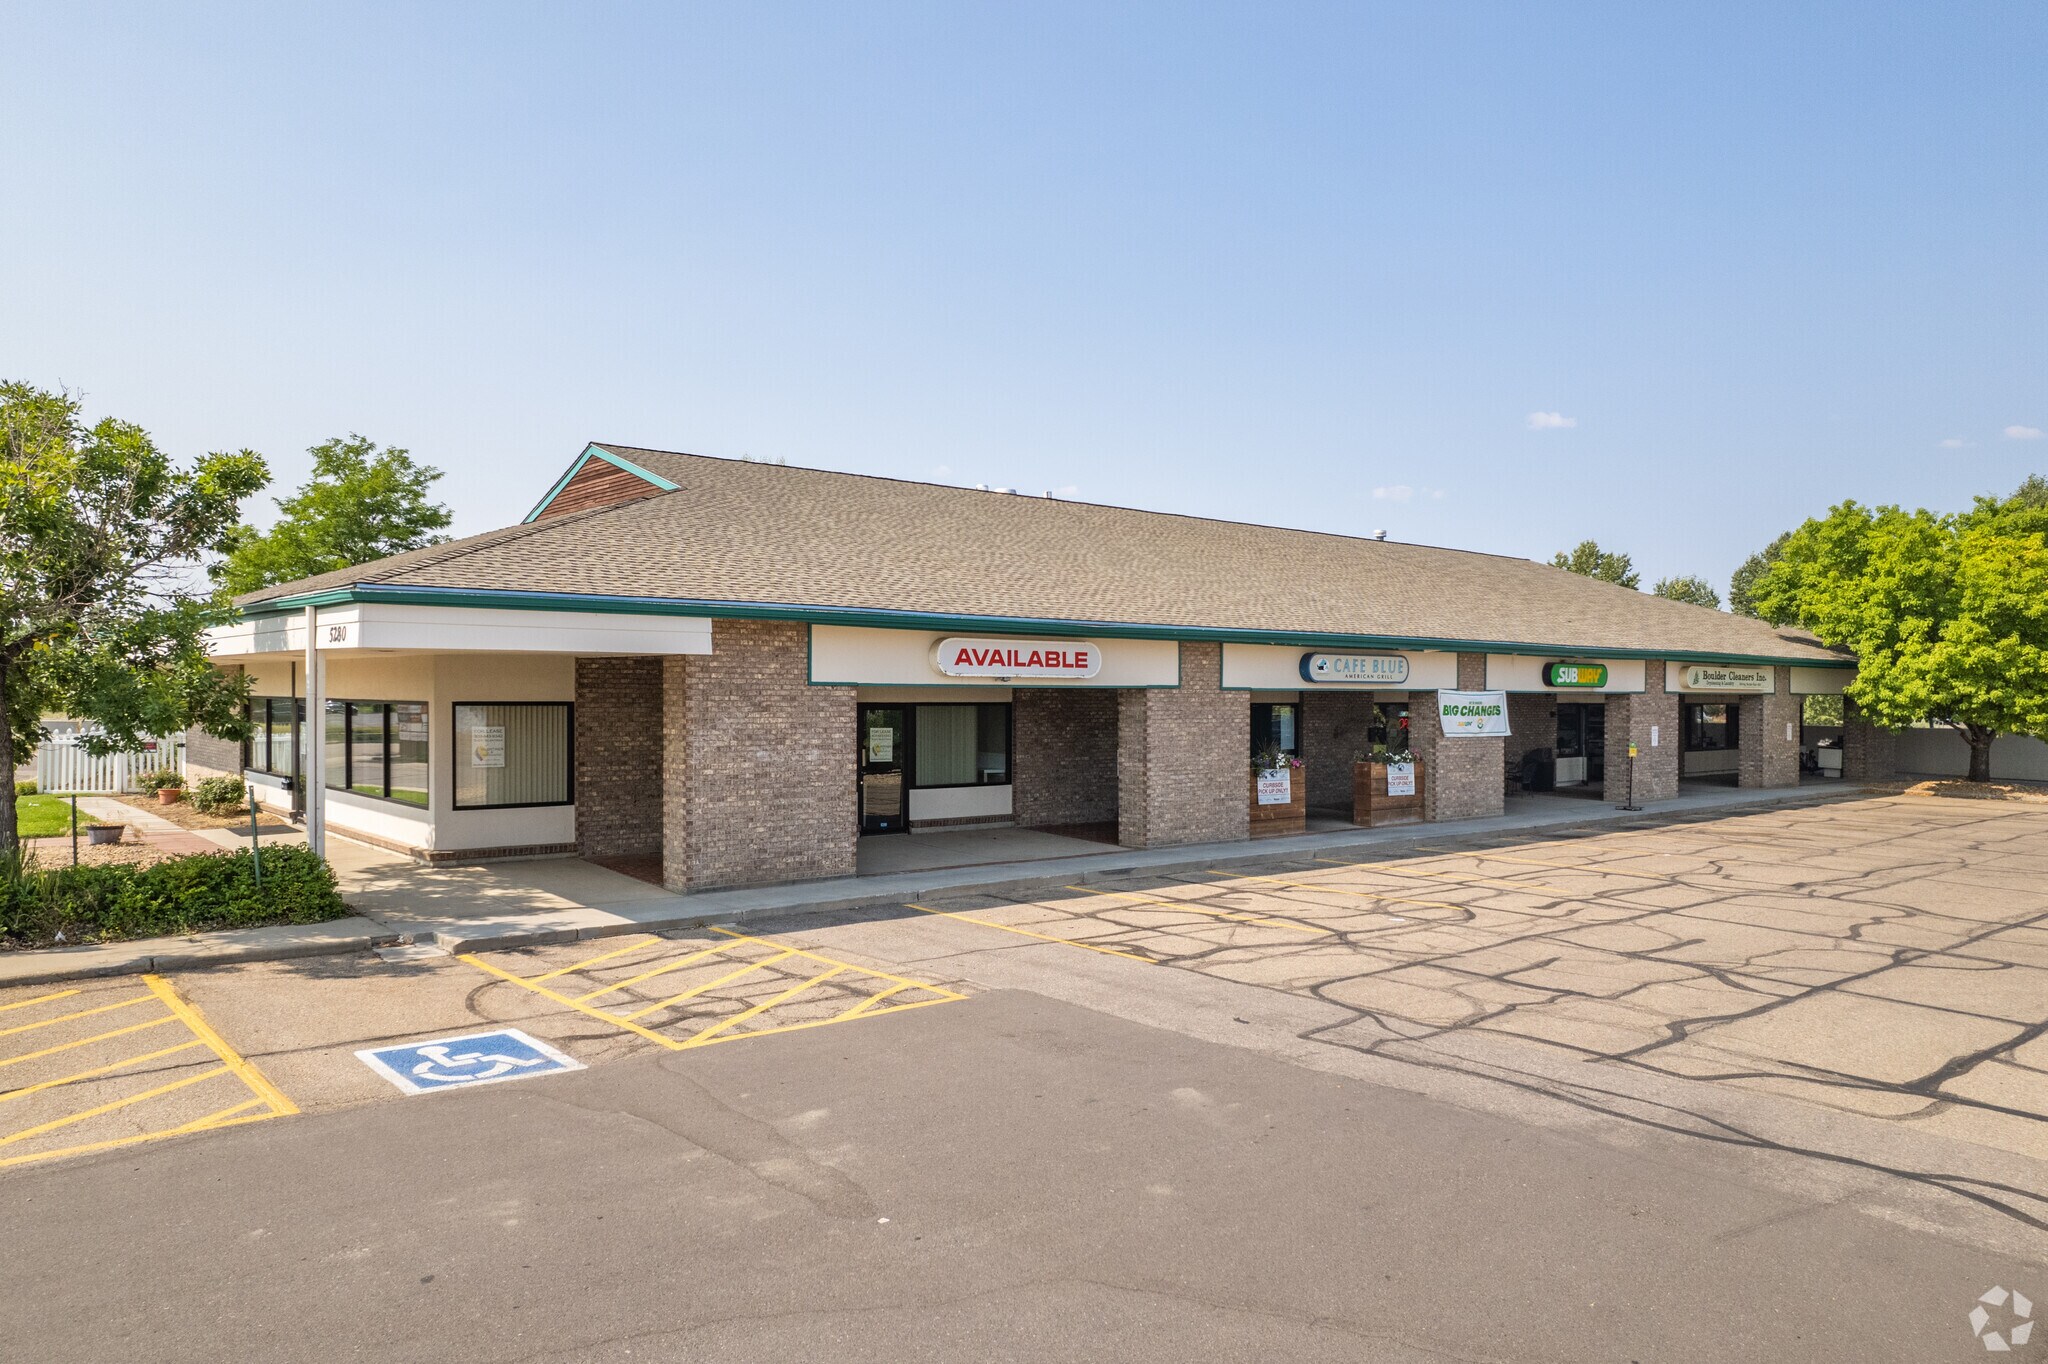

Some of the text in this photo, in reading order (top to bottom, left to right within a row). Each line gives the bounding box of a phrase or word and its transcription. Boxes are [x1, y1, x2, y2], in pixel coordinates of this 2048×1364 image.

[329, 626, 347, 643] 5280
[954, 648, 1088, 669] AVAILABLE
[1334, 658, 1403, 674] CAFE BLUE
[1557, 667, 1602, 684] SUBWAY
[1702, 670, 1767, 682] Boulder Cleaners Inc.
[1442, 704, 1459, 717] BIG
